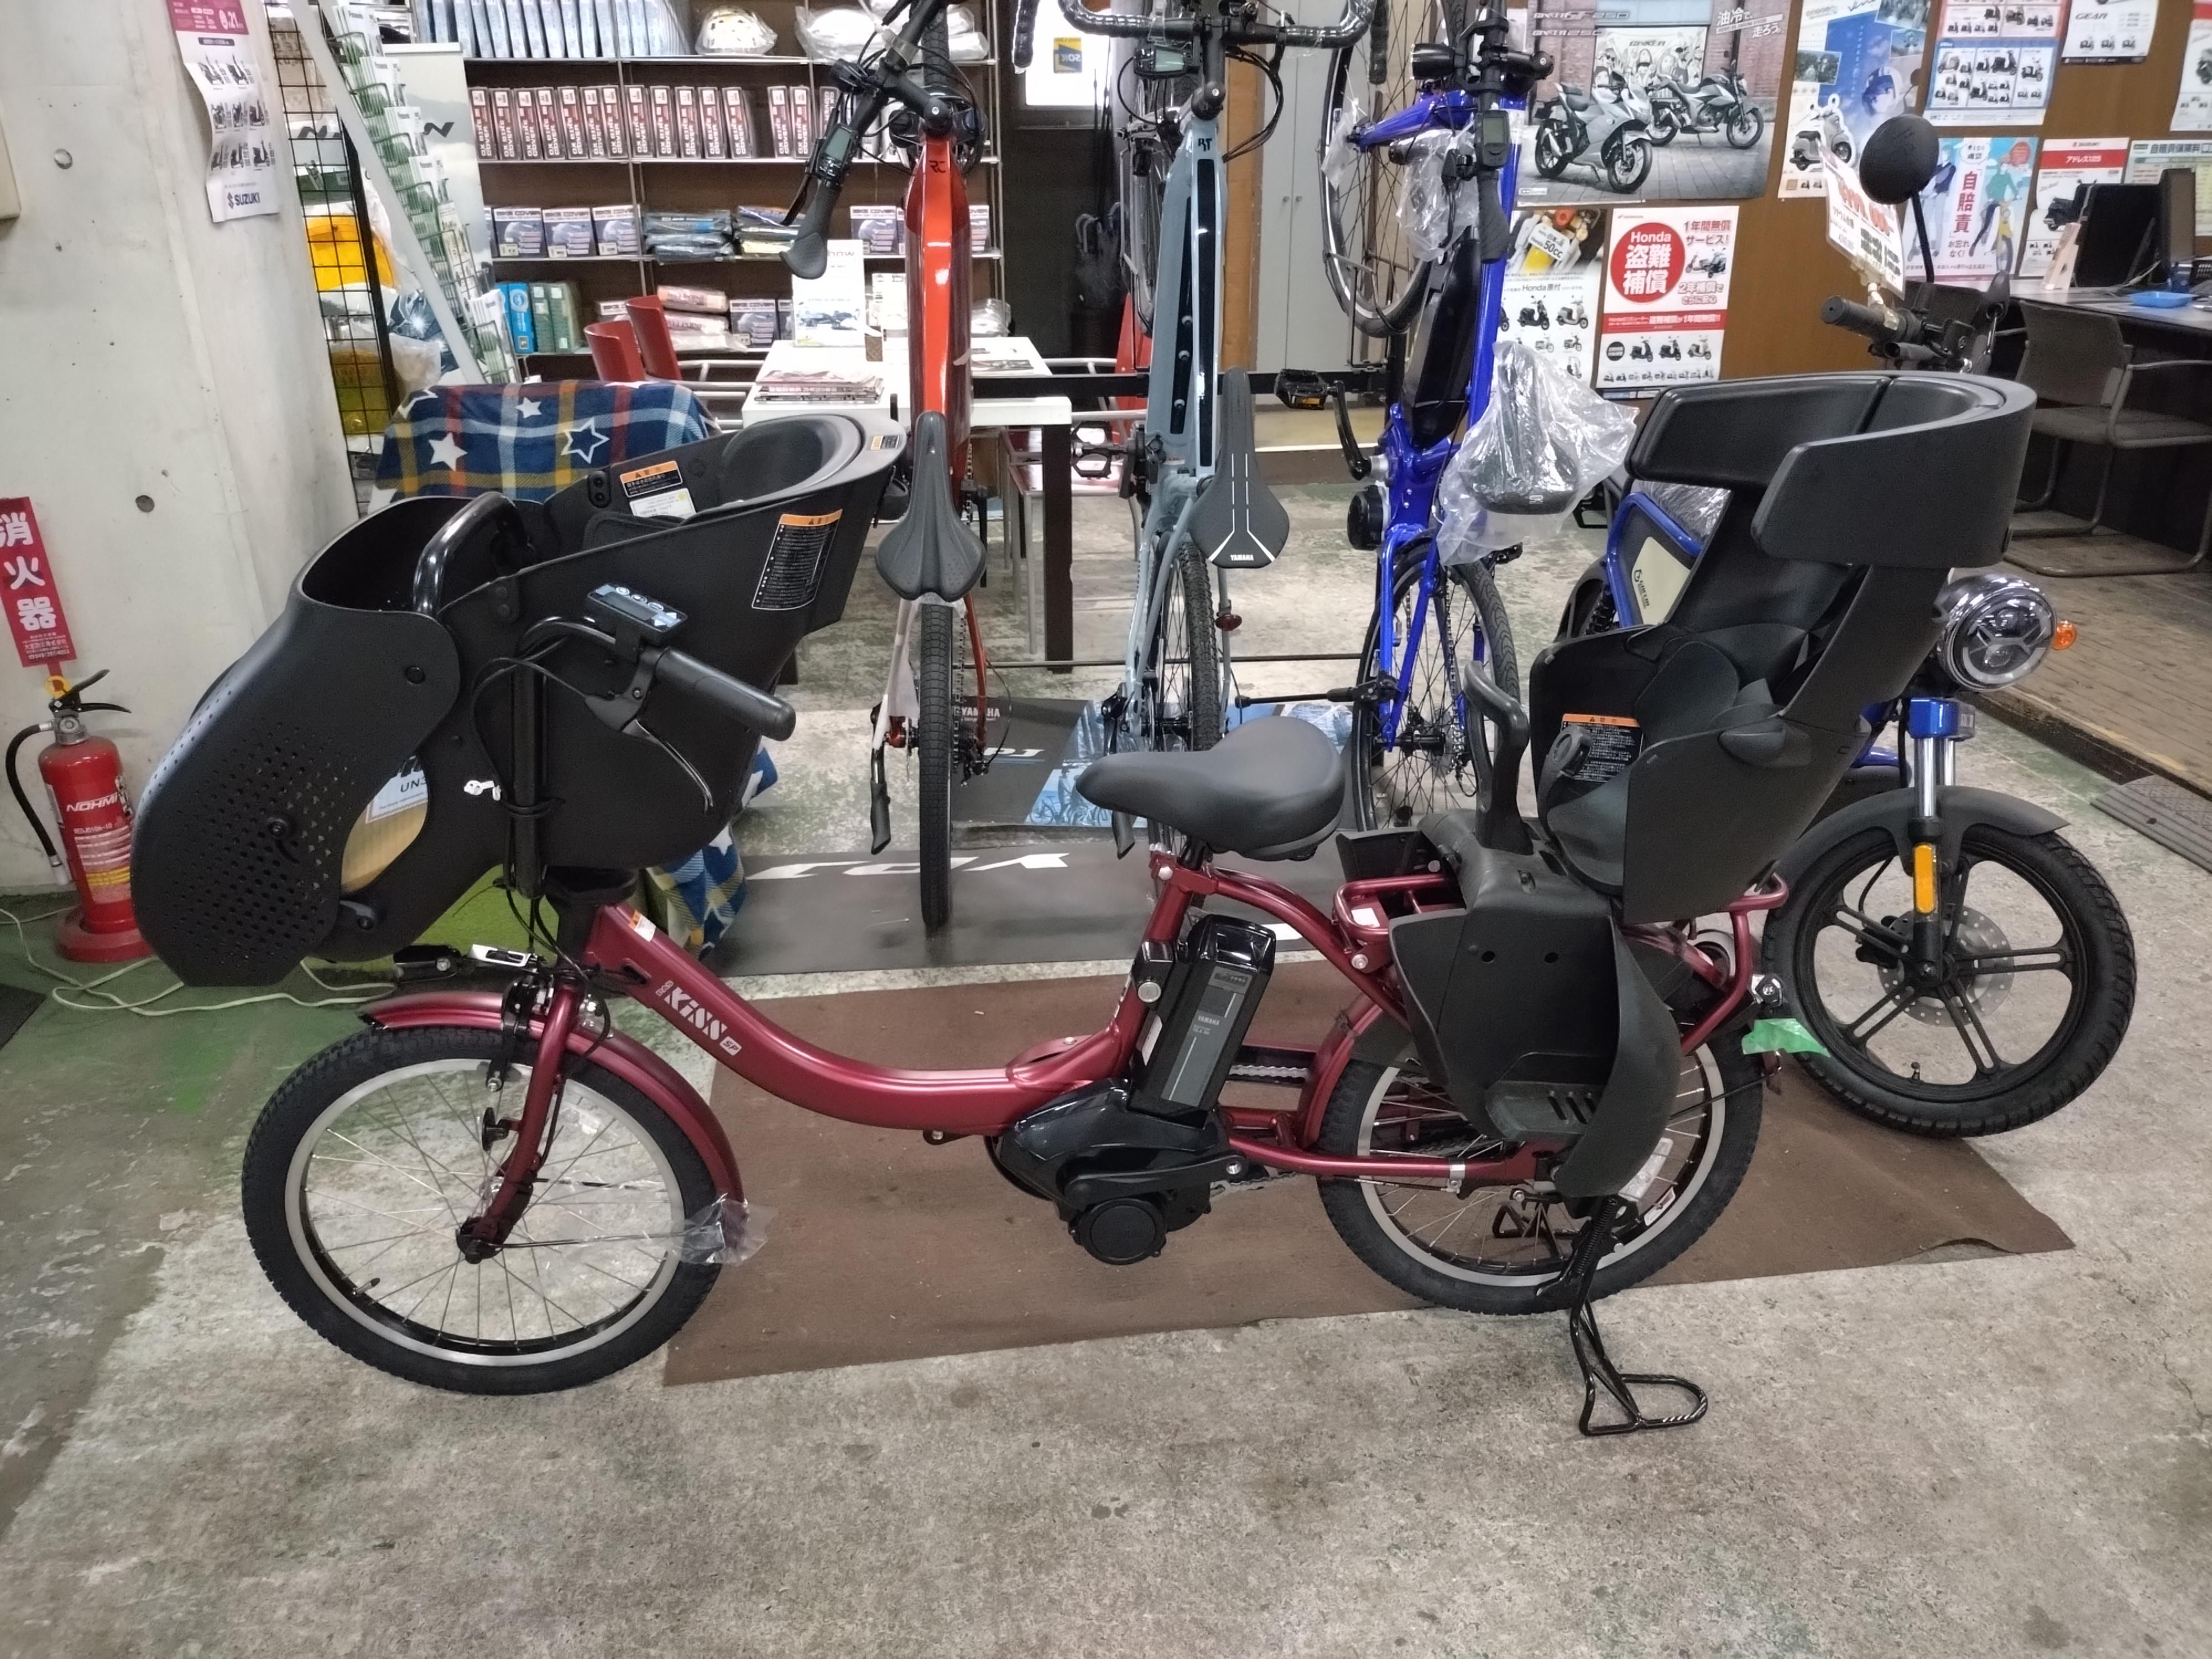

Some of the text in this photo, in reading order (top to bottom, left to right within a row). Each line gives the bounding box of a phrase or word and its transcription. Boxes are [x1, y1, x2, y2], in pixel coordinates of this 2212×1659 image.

[483, 126, 492, 156] COVER
[506, 127, 514, 157] COVER
[529, 126, 538, 156] COVER
[550, 125, 560, 155] COVER
[574, 124, 583, 154] COVER
[596, 124, 604, 155] COVER
[614, 123, 622, 154] COVER
[639, 122, 648, 153] COVER
[1198, 138, 1212, 152] RT
[234, 192, 260, 206] SUZUKI
[1631, 231, 1671, 243] Honda
[1684, 220, 1731, 232] 1年間無償
[1543, 241, 1563, 258] 50cc
[1624, 244, 1672, 269] 盗難
[1623, 269, 1668, 295] 補償
[0, 512, 56, 630] 消火器
[66, 792, 118, 812] NOHMI
